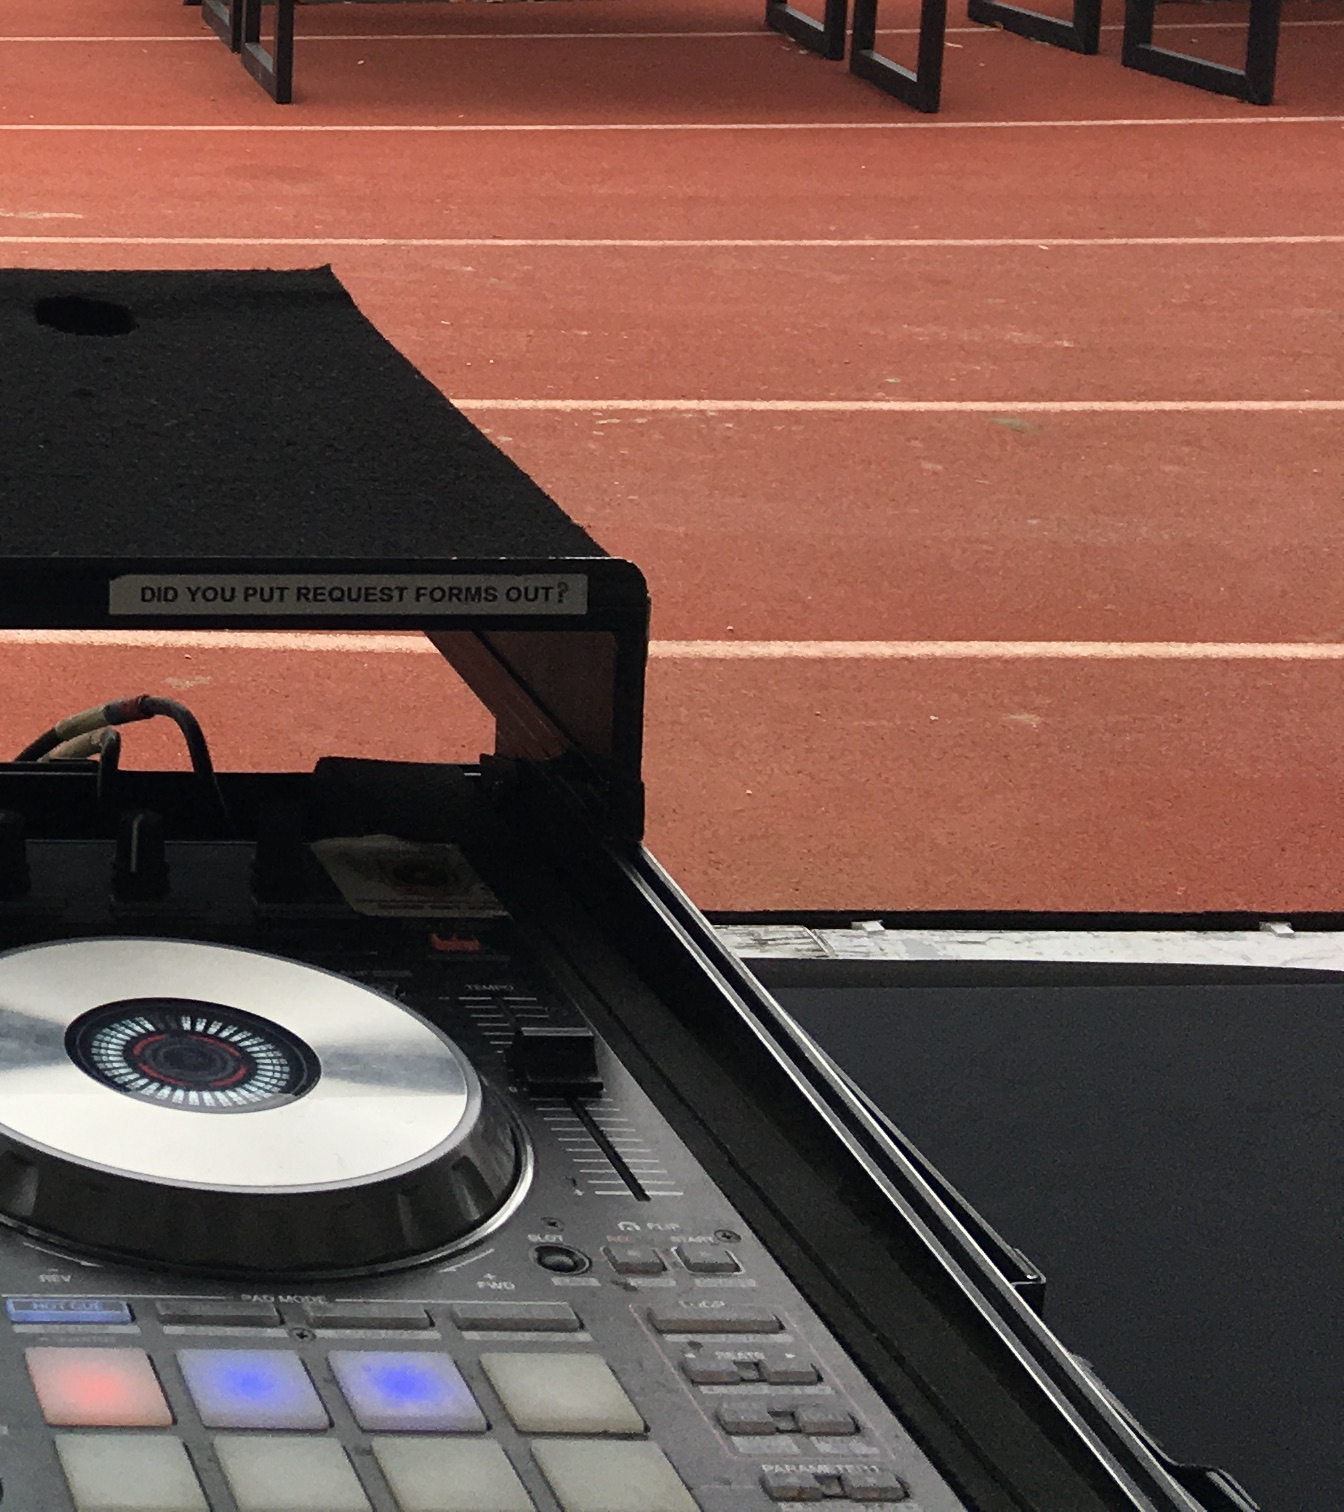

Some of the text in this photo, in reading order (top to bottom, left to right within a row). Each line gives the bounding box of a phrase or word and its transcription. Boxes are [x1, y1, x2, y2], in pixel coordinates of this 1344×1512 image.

[140, 582, 569, 604] DID YOU PUT REQUEST FORMS OUT?
